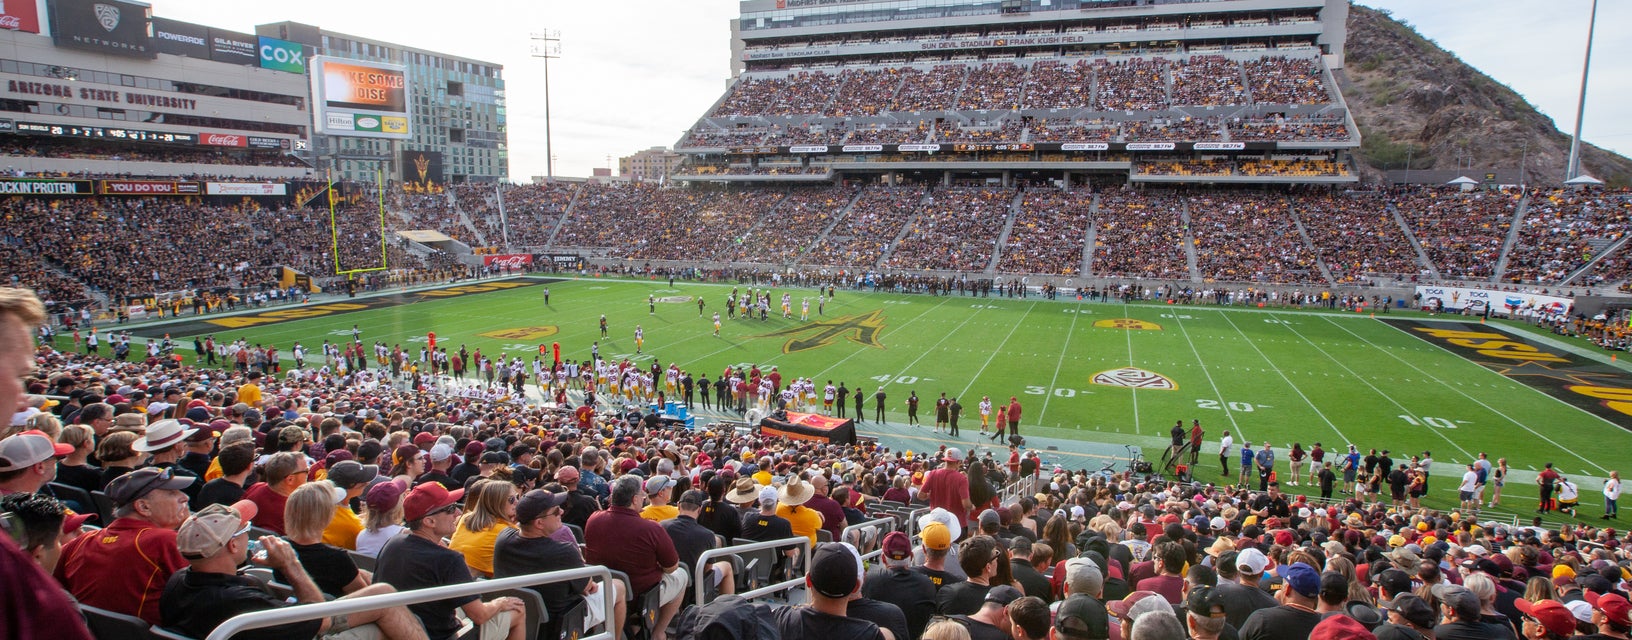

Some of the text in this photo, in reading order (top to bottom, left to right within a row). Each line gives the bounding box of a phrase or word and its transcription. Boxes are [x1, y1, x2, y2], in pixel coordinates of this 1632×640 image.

[73, 35, 145, 52] NETWORKS
[158, 31, 205, 45] POWERADE
[214, 37, 254, 49] GILA RIVER
[960, 40, 991, 48] STADIUM
[1037, 36, 1059, 44] KUSH
[260, 45, 303, 65] COX
[368, 73, 403, 88] SOME
[8, 80, 197, 110] ARIZONA STATE UNIVERSITY
[329, 117, 353, 125] Hilton
[208, 134, 239, 146] Coca-Cola
[33, 182, 76, 194] PROTEIN
[111, 183, 133, 192] YOU
[151, 184, 171, 192] YOU
[204, 303, 369, 328] ASU
[1411, 327, 1574, 363] ASU
[870, 374, 919, 385] 40
[783, 392, 792, 400] 52
[1024, 385, 1076, 398] 30
[1195, 399, 1254, 412] 20
[580, 411, 587, 421] 4
[1398, 414, 1458, 429] 10
[102, 535, 119, 544] USC
